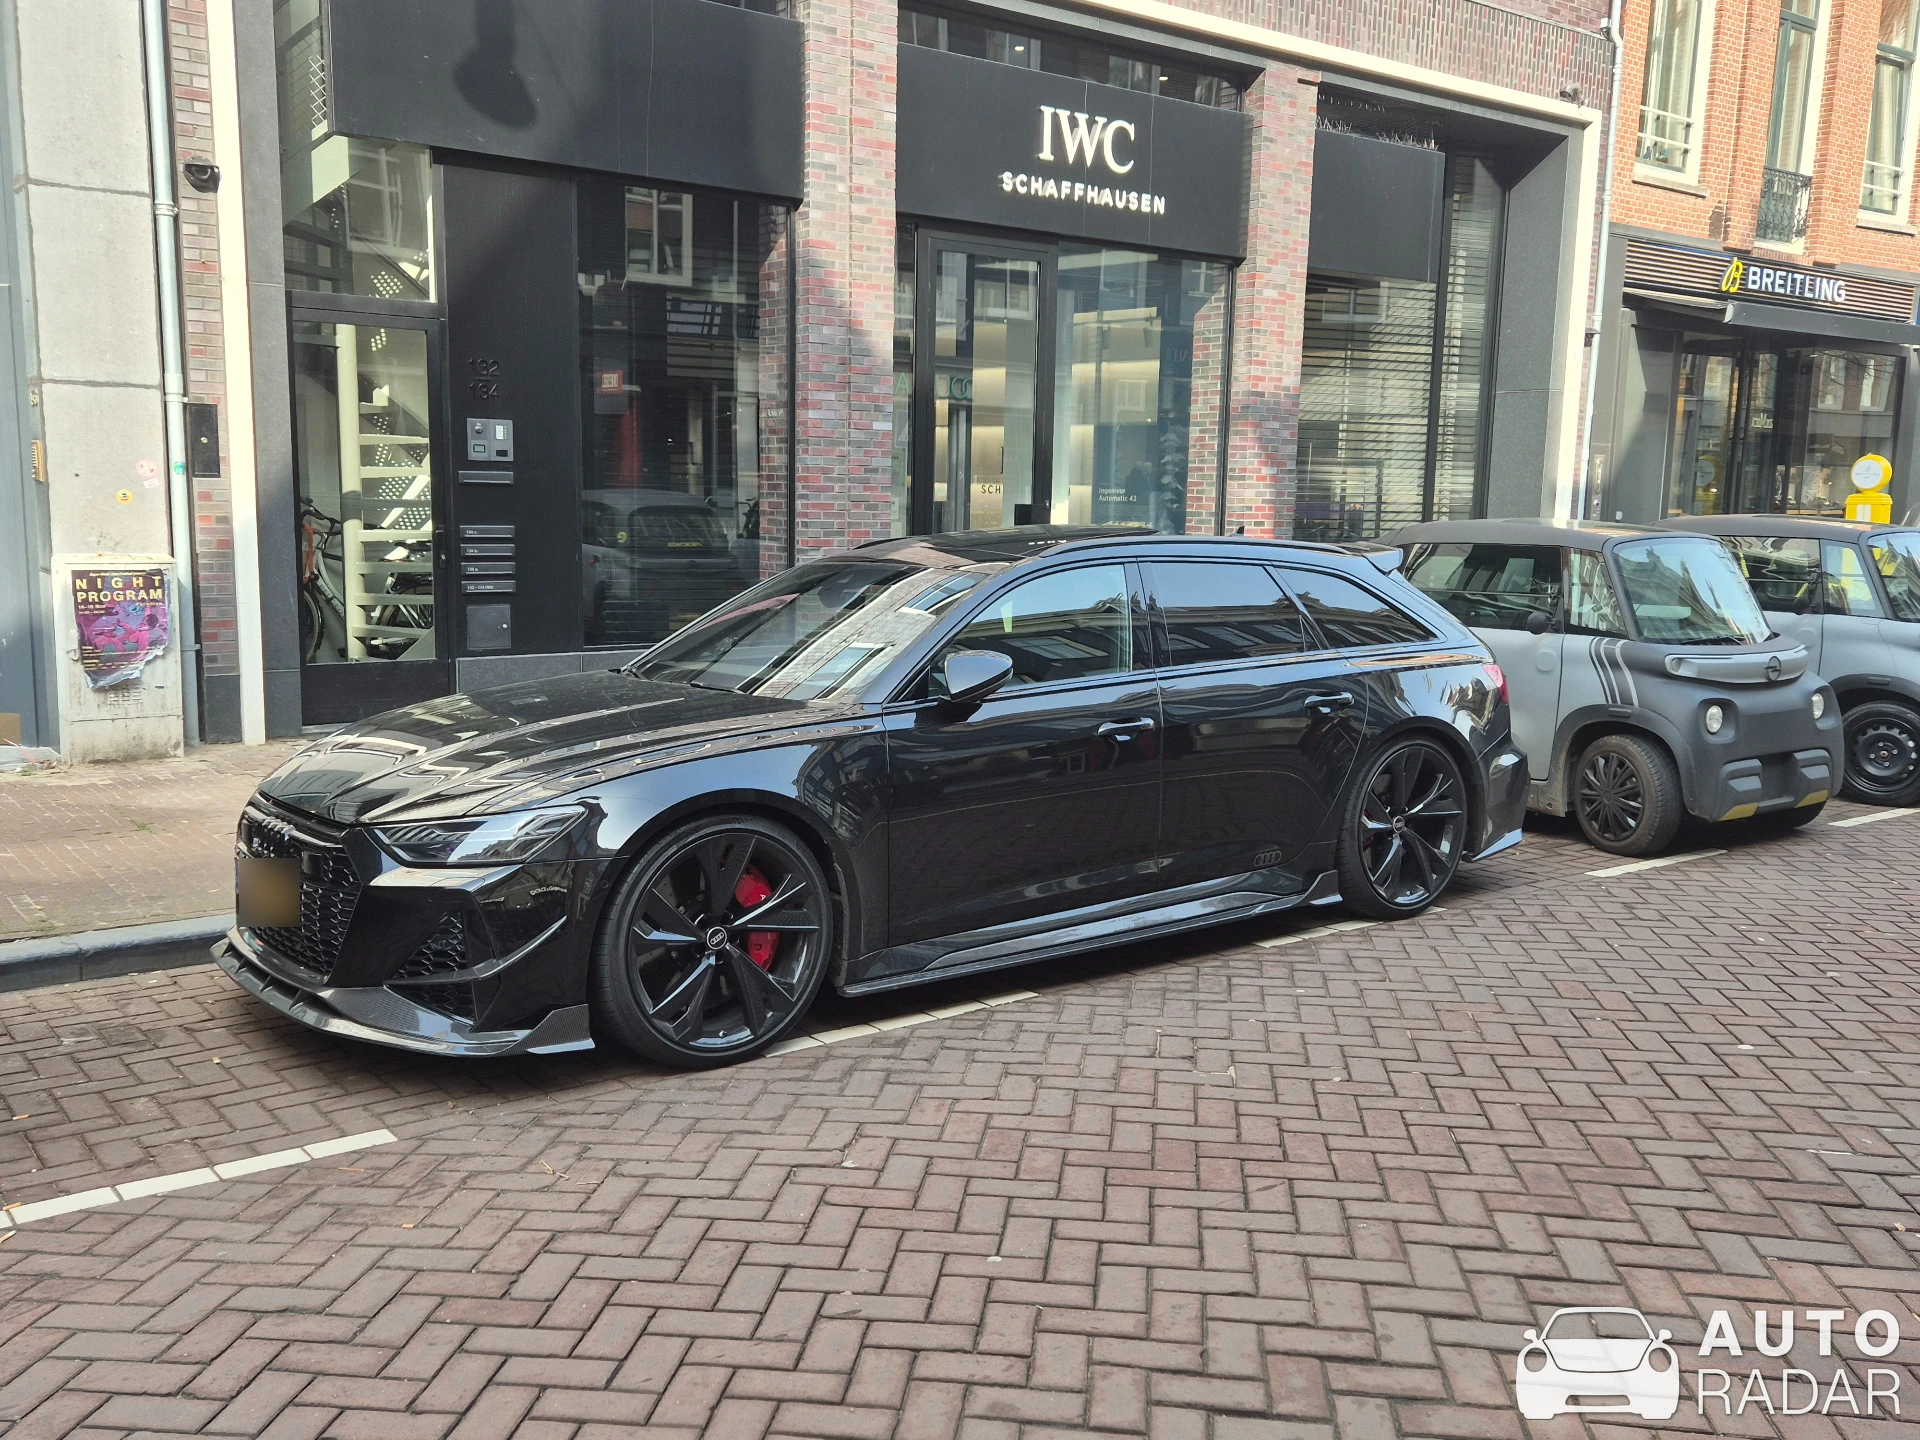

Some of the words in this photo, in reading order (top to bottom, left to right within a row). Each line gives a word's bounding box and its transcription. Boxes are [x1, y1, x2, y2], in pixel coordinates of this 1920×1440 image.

[1039, 105, 1135, 174] IWC
[1001, 171, 1166, 215] SCHAFFHAUSEN
[1747, 266, 1846, 303] BREITLING
[468, 359, 499, 375] 132
[468, 383, 499, 399] 134
[75, 576, 162, 590] NIGHT
[76, 589, 163, 603] PROGRAM
